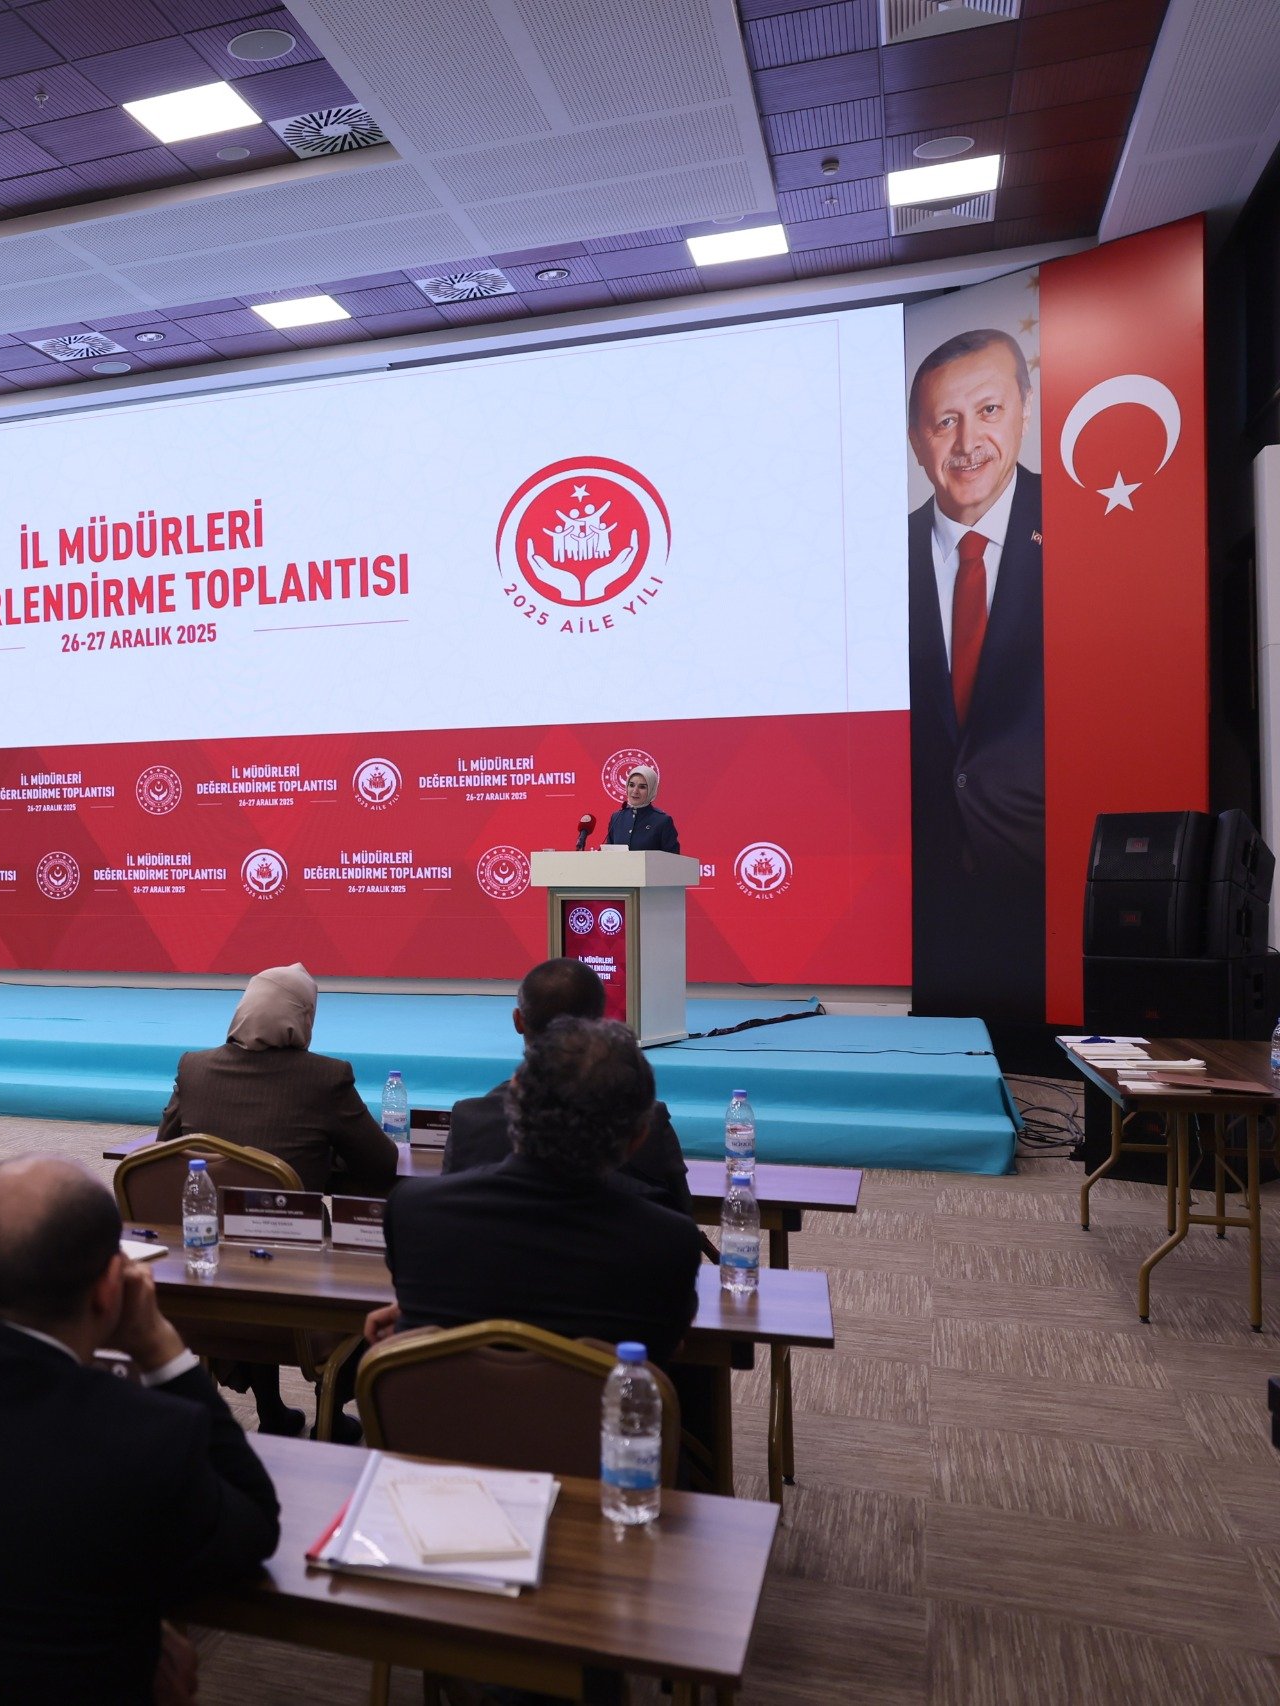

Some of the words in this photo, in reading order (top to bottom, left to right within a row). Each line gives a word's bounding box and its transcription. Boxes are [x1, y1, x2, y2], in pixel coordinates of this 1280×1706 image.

[20, 524, 48, 570] İL
[59, 499, 263, 566] MÜDÜRLERİ
[185, 553, 410, 612] TOPLANTISI
[504, 583, 549, 625] 2025
[560, 615, 614, 633] AİLE
[623, 576, 663, 615] YILI
[61, 631, 106, 653] 26-27
[111, 627, 174, 650] ARALIK
[179, 623, 216, 647] 2025
[232, 766, 240, 778] İL
[243, 763, 300, 778] MÜDÜRLERİ
[458, 757, 468, 771] İL
[471, 755, 533, 771] MÜDÜRLERİ
[20, 773, 29, 786] İL
[31, 771, 81, 785] MÜDÜRLERİ
[419, 773, 508, 788] DEĞERLENDİRME
[511, 772, 575, 786] TOPLANTISI
[62, 786, 115, 798] TOPLANTISI
[197, 781, 276, 794] DEĞERLENDİRME
[278, 779, 337, 792] TOPLANTISI
[466, 793, 483, 801] 26-27
[485, 792, 510, 800] ARALIK
[511, 792, 527, 800] 2025
[127, 853, 135, 866] İL
[137, 852, 191, 866] MÜDÜRLERİ
[341, 850, 349, 864] İL
[352, 850, 412, 864] MÜDÜRLERİ
[94, 867, 168, 881] DEĞERLENDİRME
[170, 868, 226, 880] TOPLANTISI
[304, 866, 387, 879] DEĞERLENDİRME
[390, 867, 451, 879] TOPLANTISI
